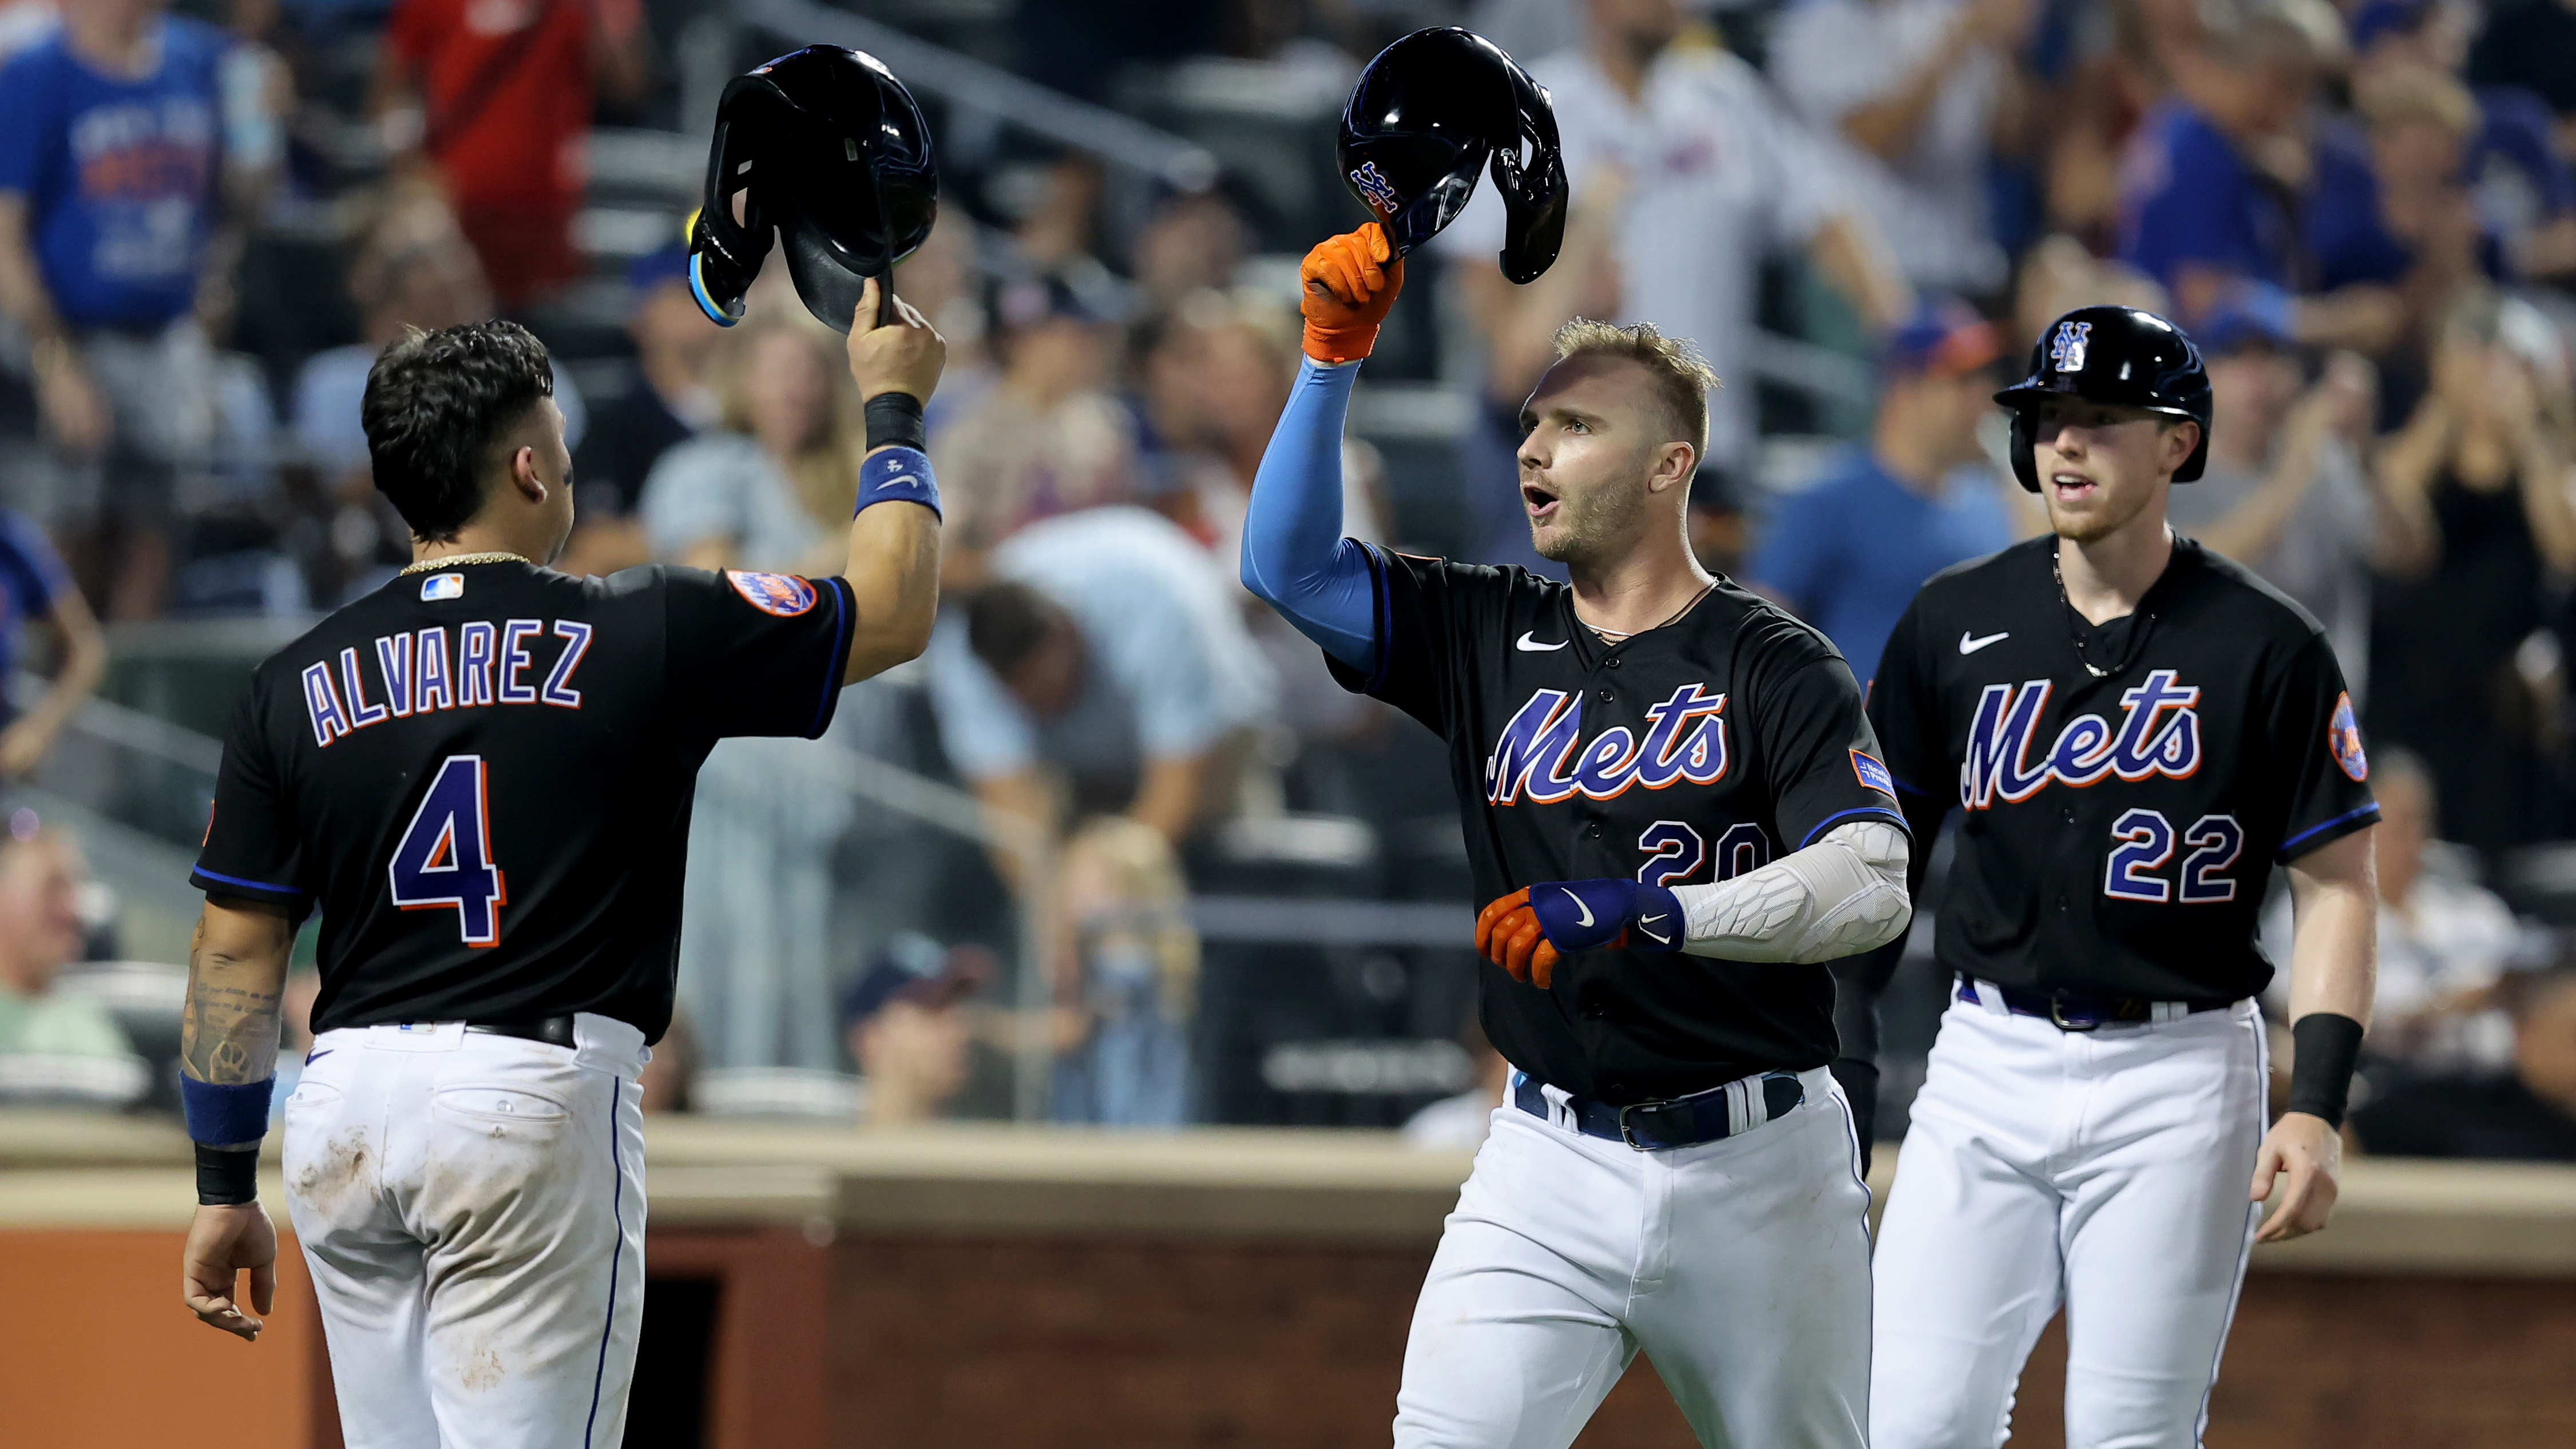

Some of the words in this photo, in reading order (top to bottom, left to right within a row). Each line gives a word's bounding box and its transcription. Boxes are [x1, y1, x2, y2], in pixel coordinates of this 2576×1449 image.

[302, 619, 593, 748] ALVAREZ
[1486, 682, 1728, 807] Mets
[1960, 669, 2201, 811] Mets
[389, 755, 508, 948] 4
[1638, 820, 1770, 887] 20
[2104, 808, 2244, 903] 22
